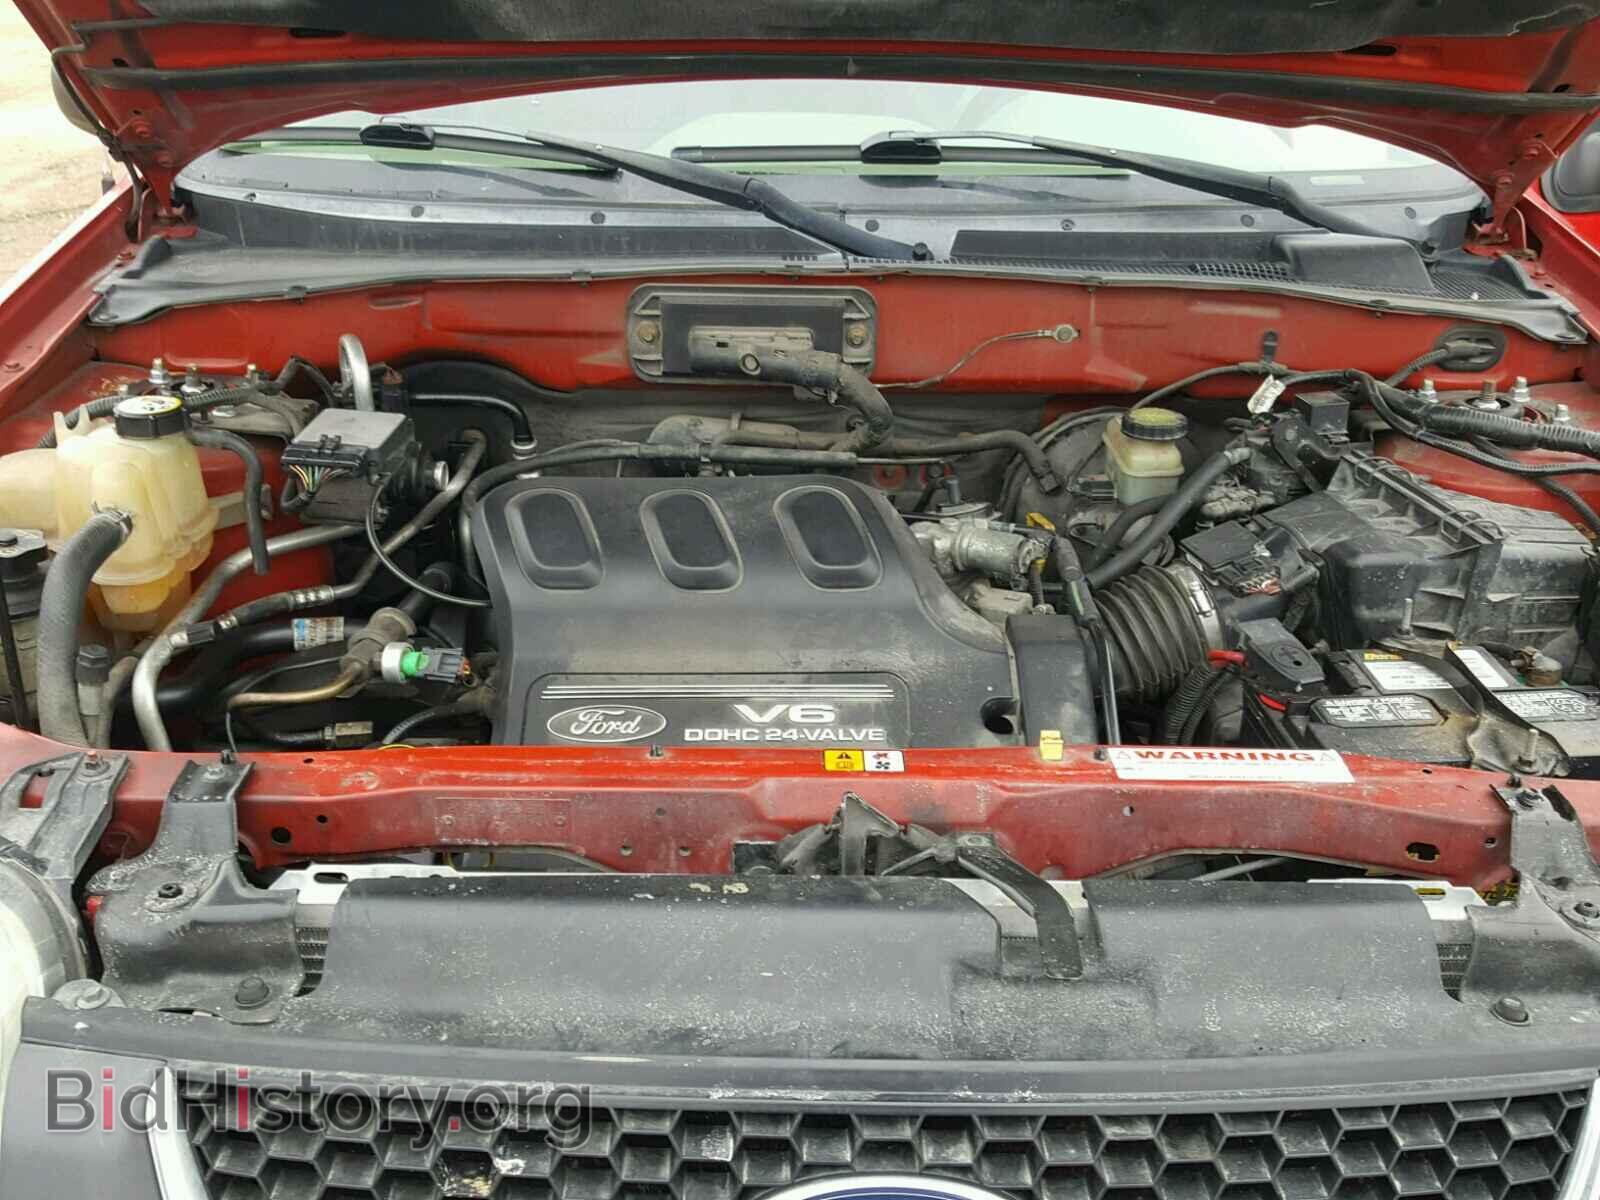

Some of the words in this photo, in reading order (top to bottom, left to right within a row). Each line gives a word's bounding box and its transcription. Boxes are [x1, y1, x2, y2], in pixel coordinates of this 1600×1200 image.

[570, 706, 642, 736] Ford
[732, 703, 837, 724] V6
[683, 727, 760, 742] DOHC
[764, 727, 887, 742] 24-VALVE
[1134, 750, 1316, 763] WARNING
